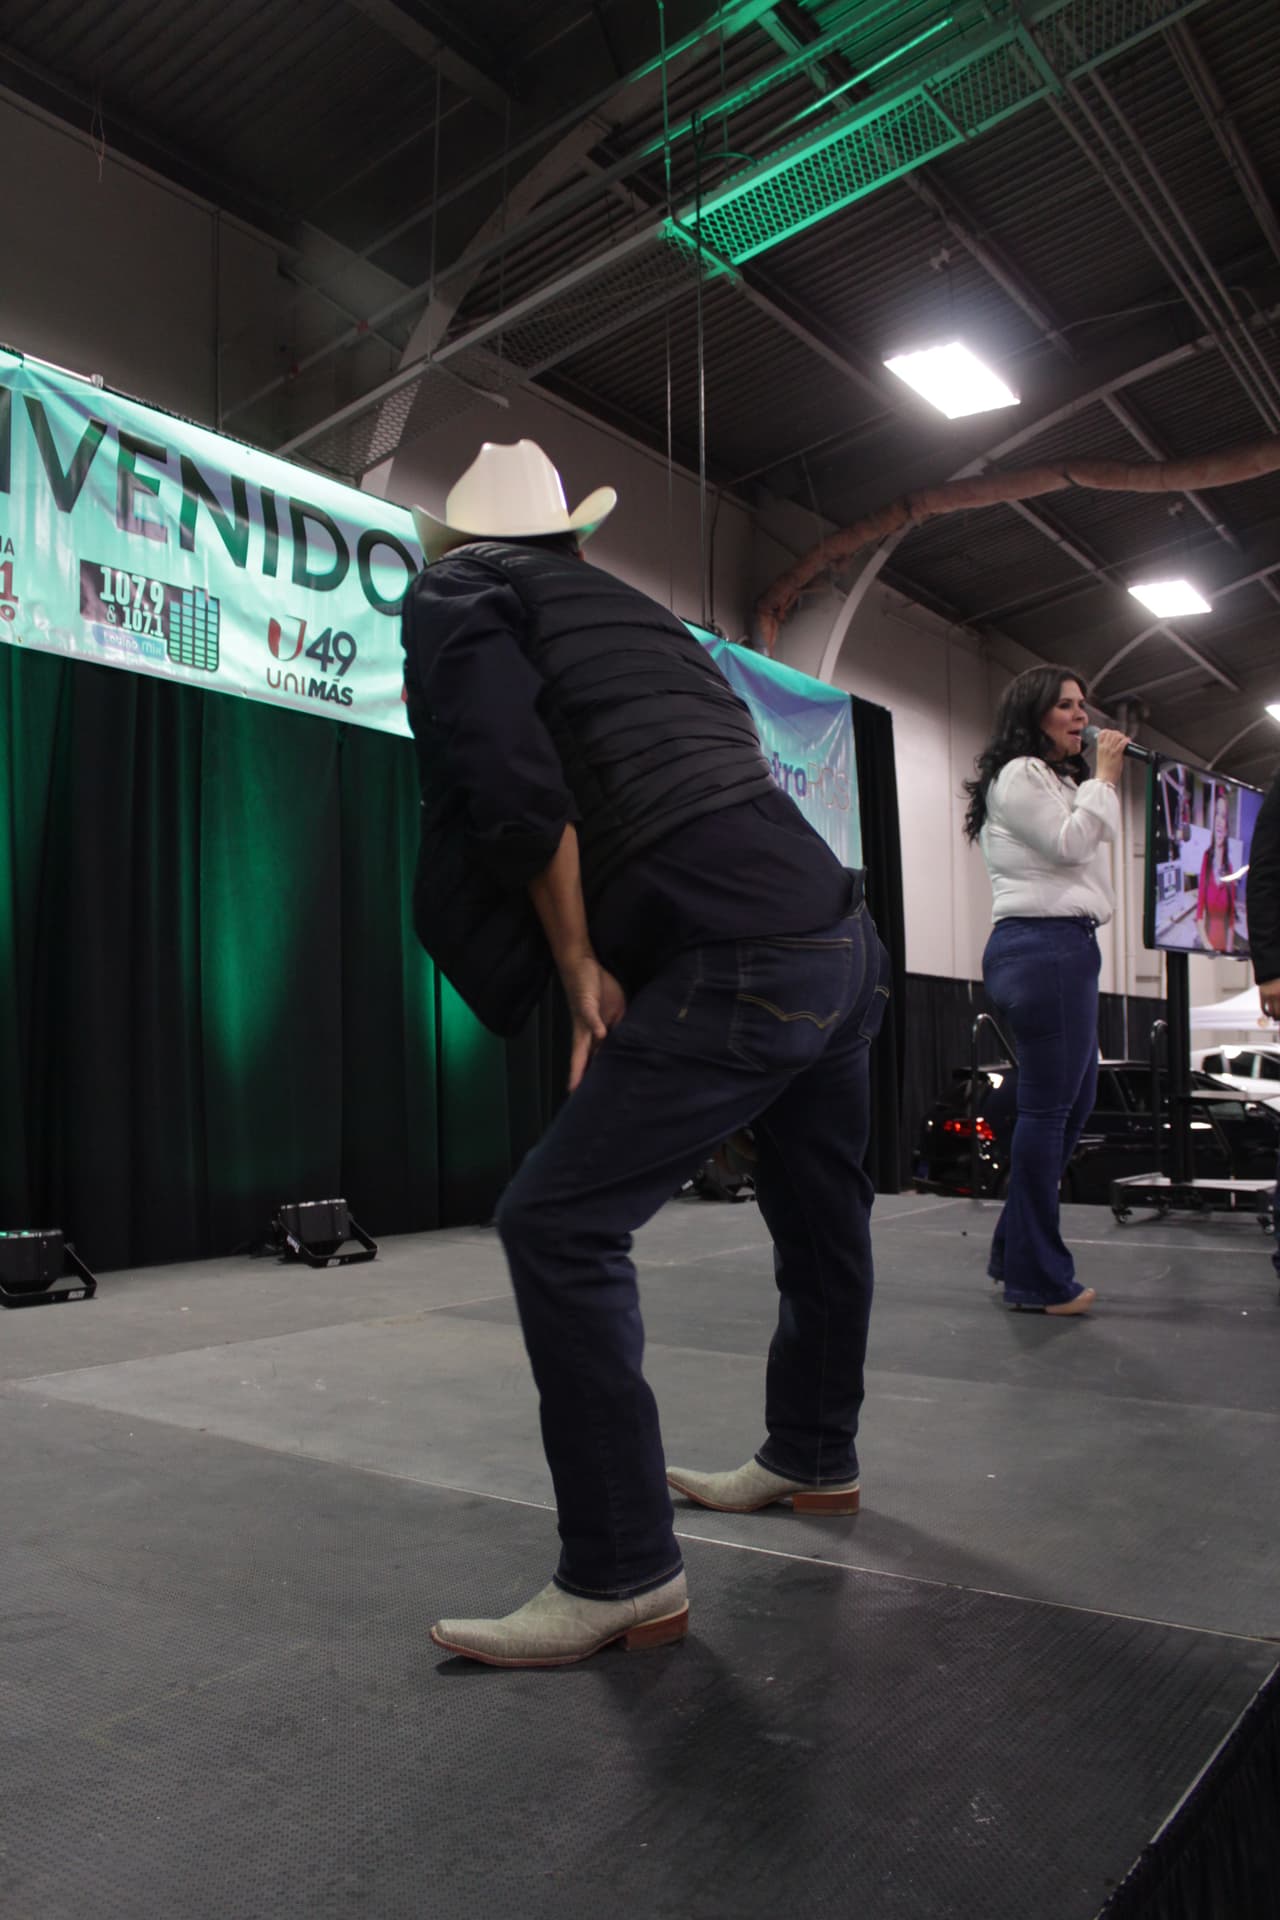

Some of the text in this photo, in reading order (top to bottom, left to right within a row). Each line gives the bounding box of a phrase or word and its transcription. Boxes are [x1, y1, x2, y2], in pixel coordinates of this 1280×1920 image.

[0, 385, 428, 617] VENIDO
[100, 565, 165, 615] 107.9
[106, 604, 165, 639] & 107.1
[304, 626, 358, 678] 49
